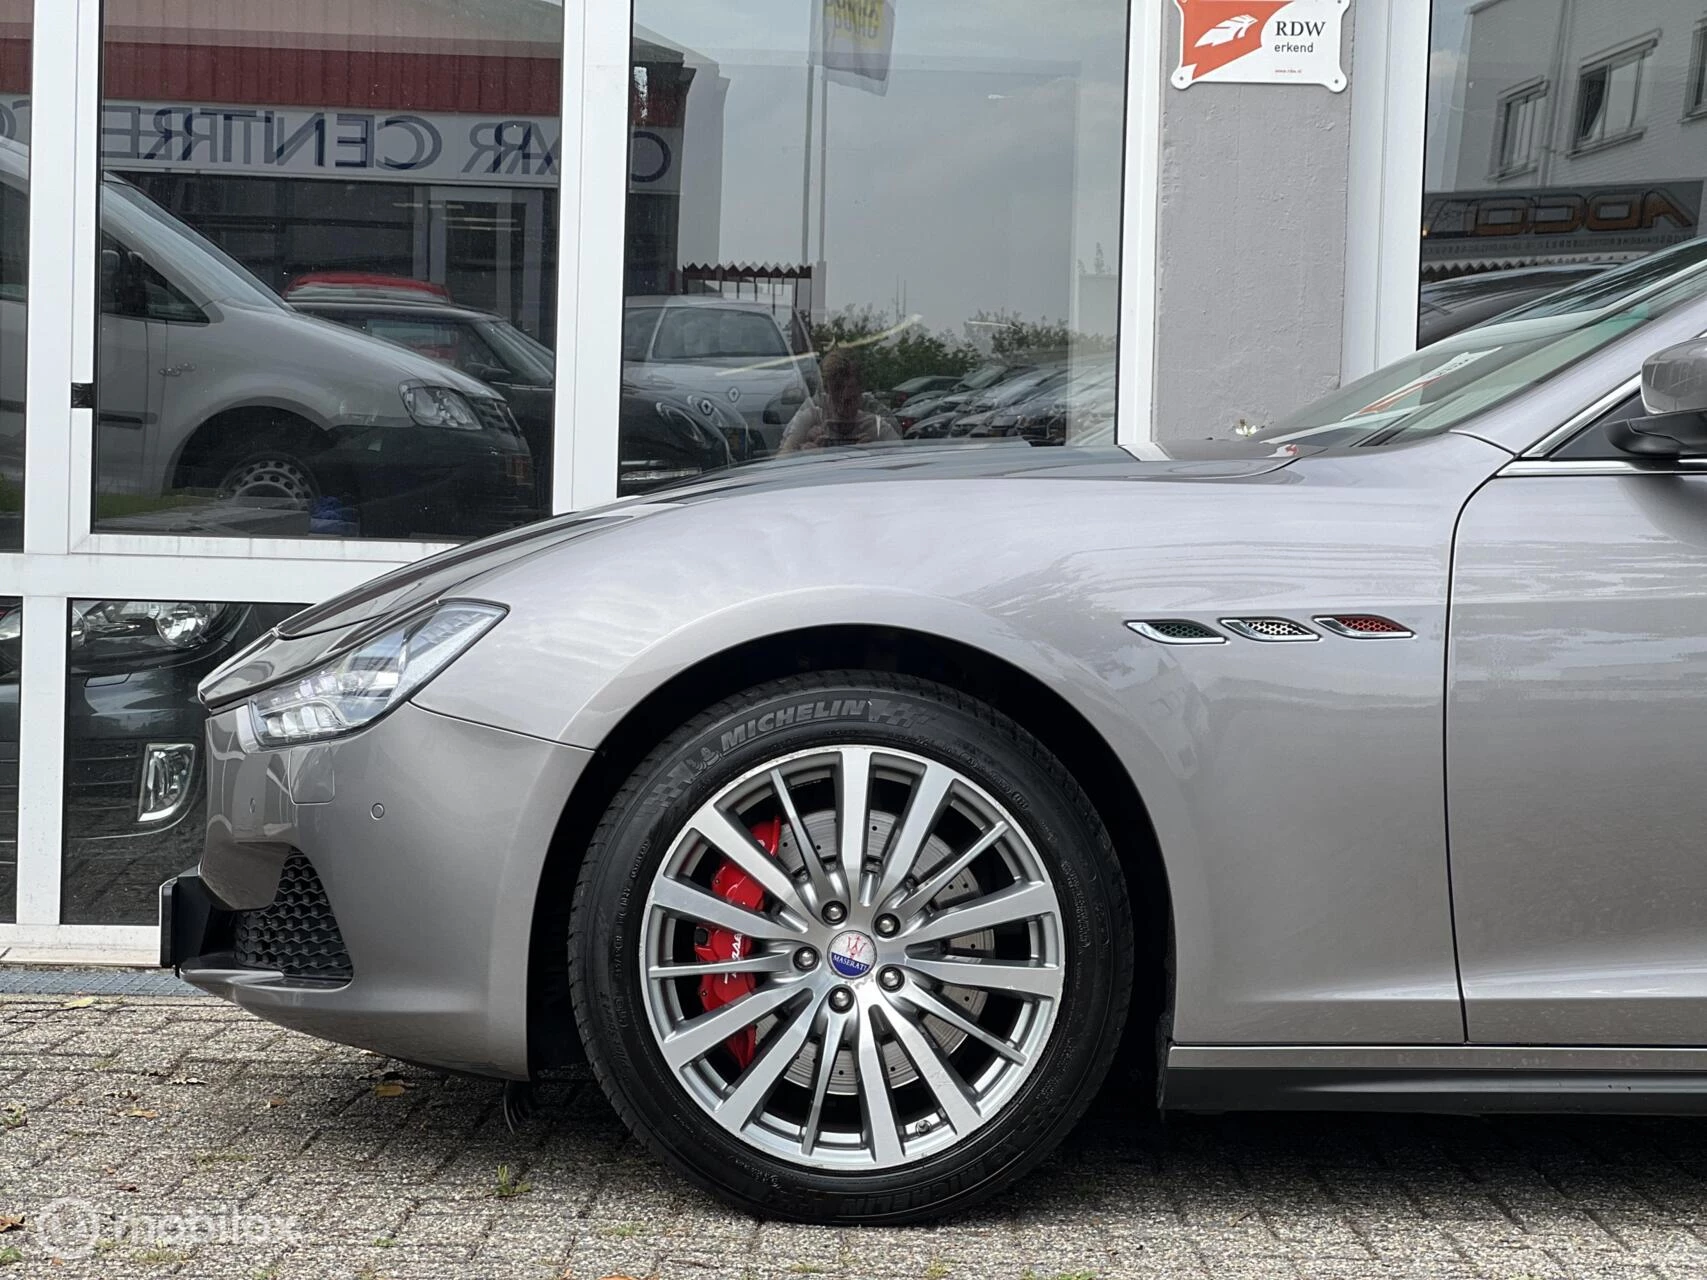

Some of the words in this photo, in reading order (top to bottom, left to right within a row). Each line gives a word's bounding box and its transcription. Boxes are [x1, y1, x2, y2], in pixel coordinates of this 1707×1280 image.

[1275, 20, 1327, 37] RDW
[1274, 42, 1314, 53] erkend
[720, 699, 870, 751] MICHELIN
[832, 954, 868, 971] MASERATI
